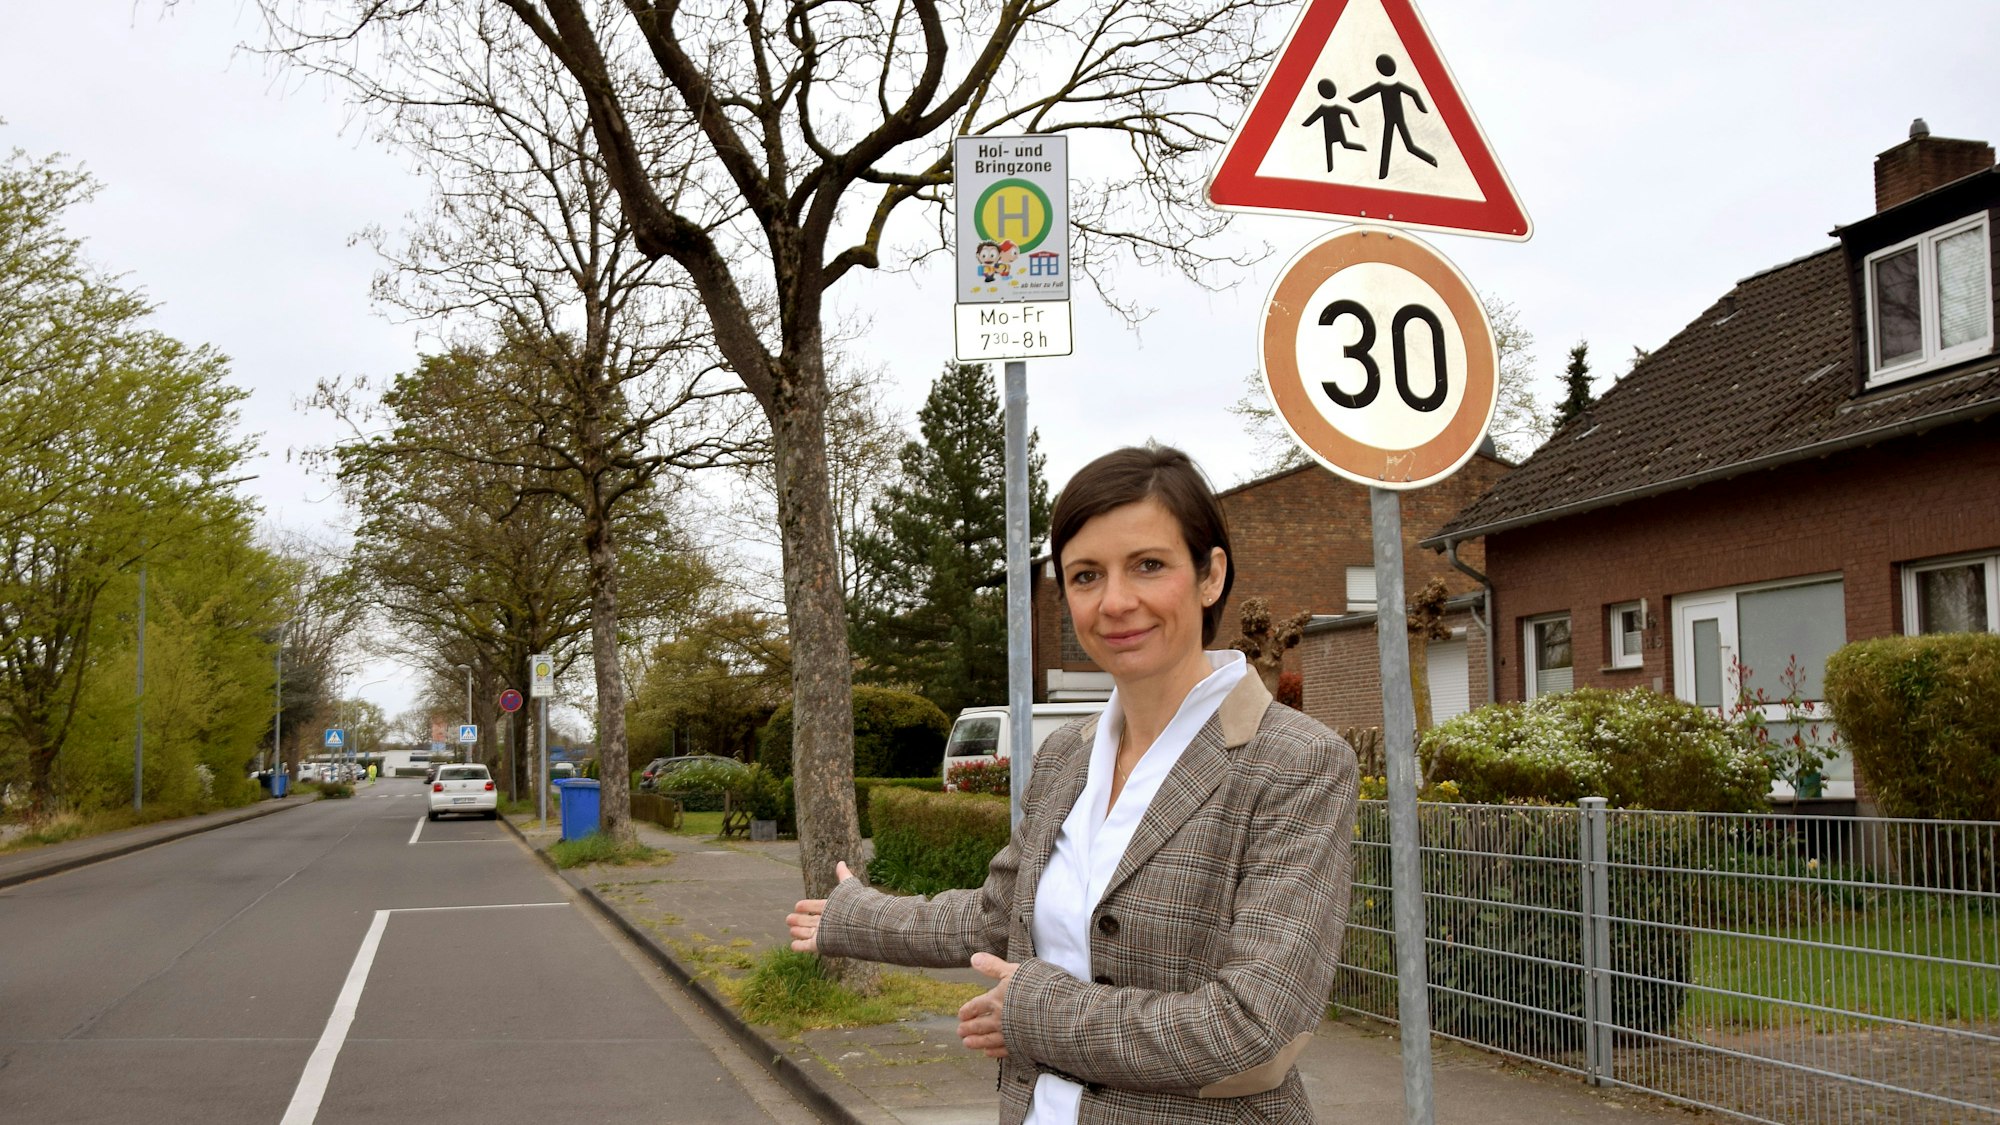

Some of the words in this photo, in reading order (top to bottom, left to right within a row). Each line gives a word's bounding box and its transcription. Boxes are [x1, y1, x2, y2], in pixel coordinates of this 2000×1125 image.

[979, 144, 1009, 157] Hol-
[1015, 144, 1042, 156] und
[975, 160, 1052, 176] Bringzone
[997, 194, 1029, 238] H
[1318, 298, 1448, 413] 30
